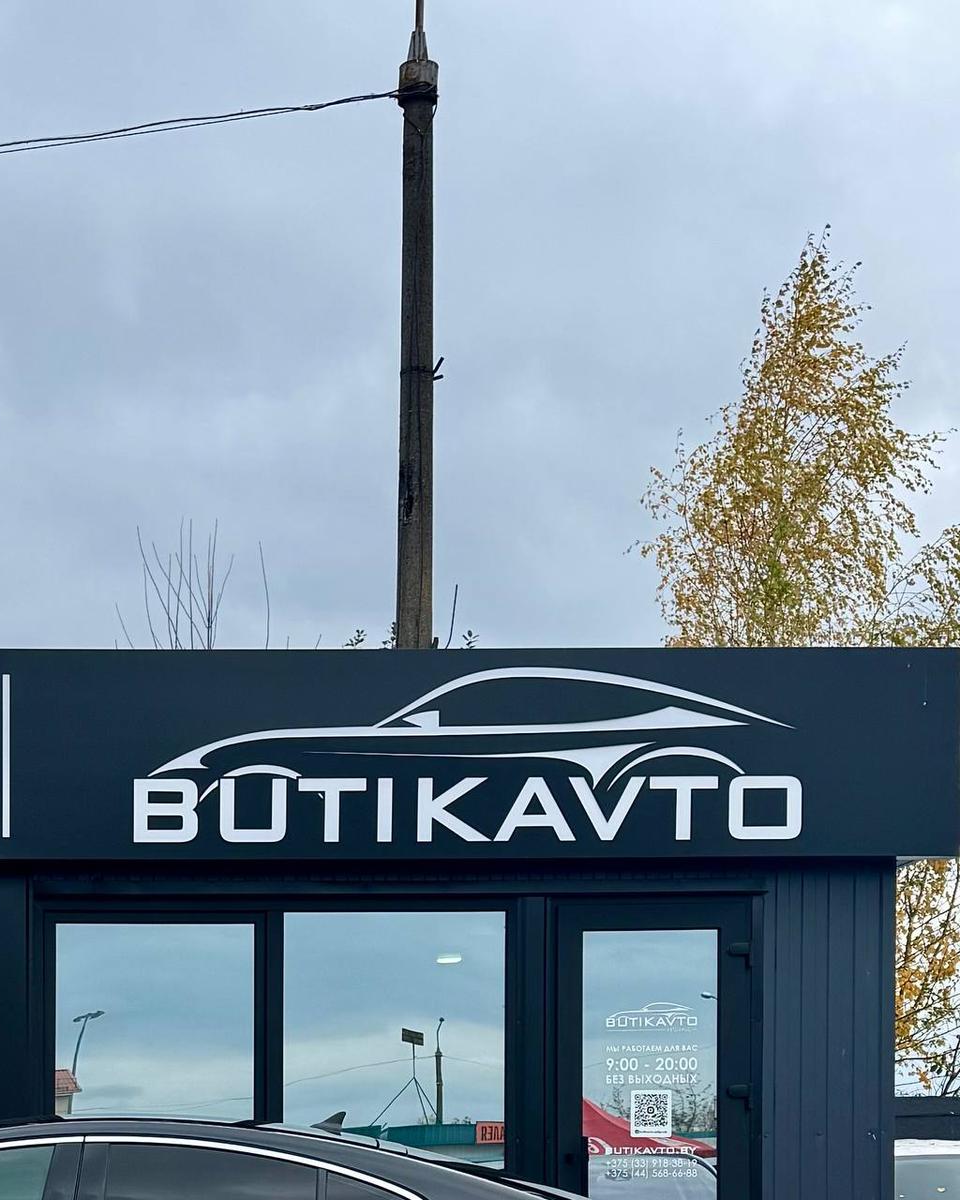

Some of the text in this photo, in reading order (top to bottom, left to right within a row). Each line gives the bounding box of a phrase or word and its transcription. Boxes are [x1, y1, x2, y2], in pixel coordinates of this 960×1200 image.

[133, 775, 803, 843] BUTIKAVTO
[606, 1016, 698, 1028] BUTIKAVTO
[606, 1058, 639, 1072] 9:00
[655, 1057, 698, 1071] 20:00
[606, 1074, 698, 1085] БЕЗ ВЫХОДНЫХ
[605, 1147, 696, 1155] BUTIKAVTO.BY
